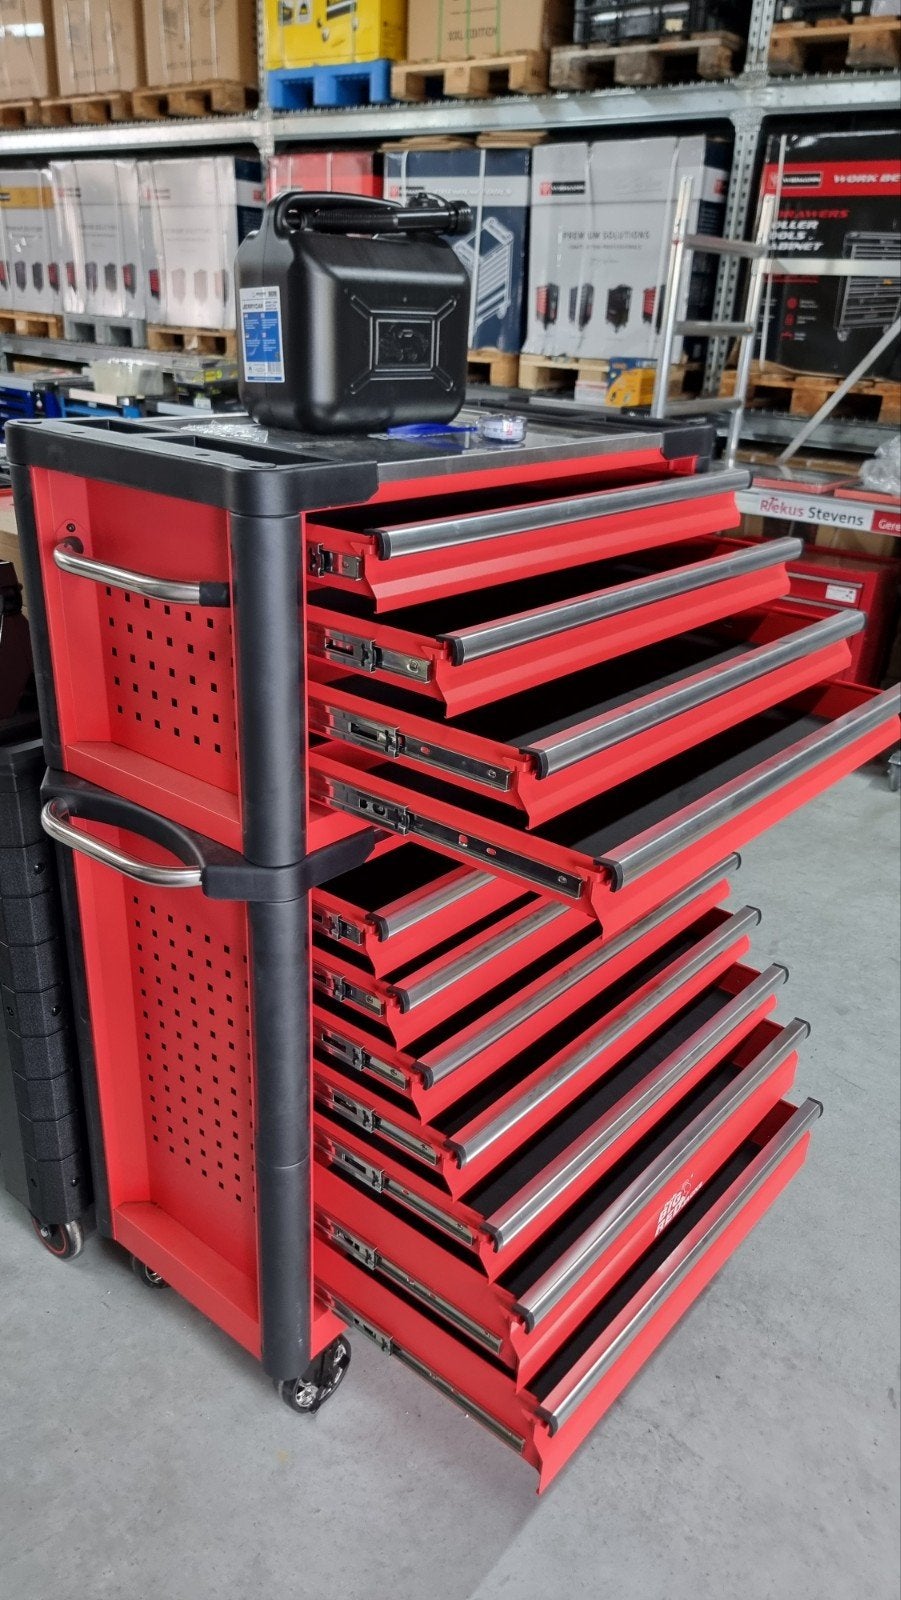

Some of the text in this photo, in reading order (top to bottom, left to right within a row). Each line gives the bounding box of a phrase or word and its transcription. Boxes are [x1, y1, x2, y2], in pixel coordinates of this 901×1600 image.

[834, 174, 879, 183] WORK
[771, 220, 820, 230] OLLER
[768, 231, 807, 241] OOLS
[767, 241, 824, 251] ABINET
[759, 497, 864, 527] Riekus Stevens
